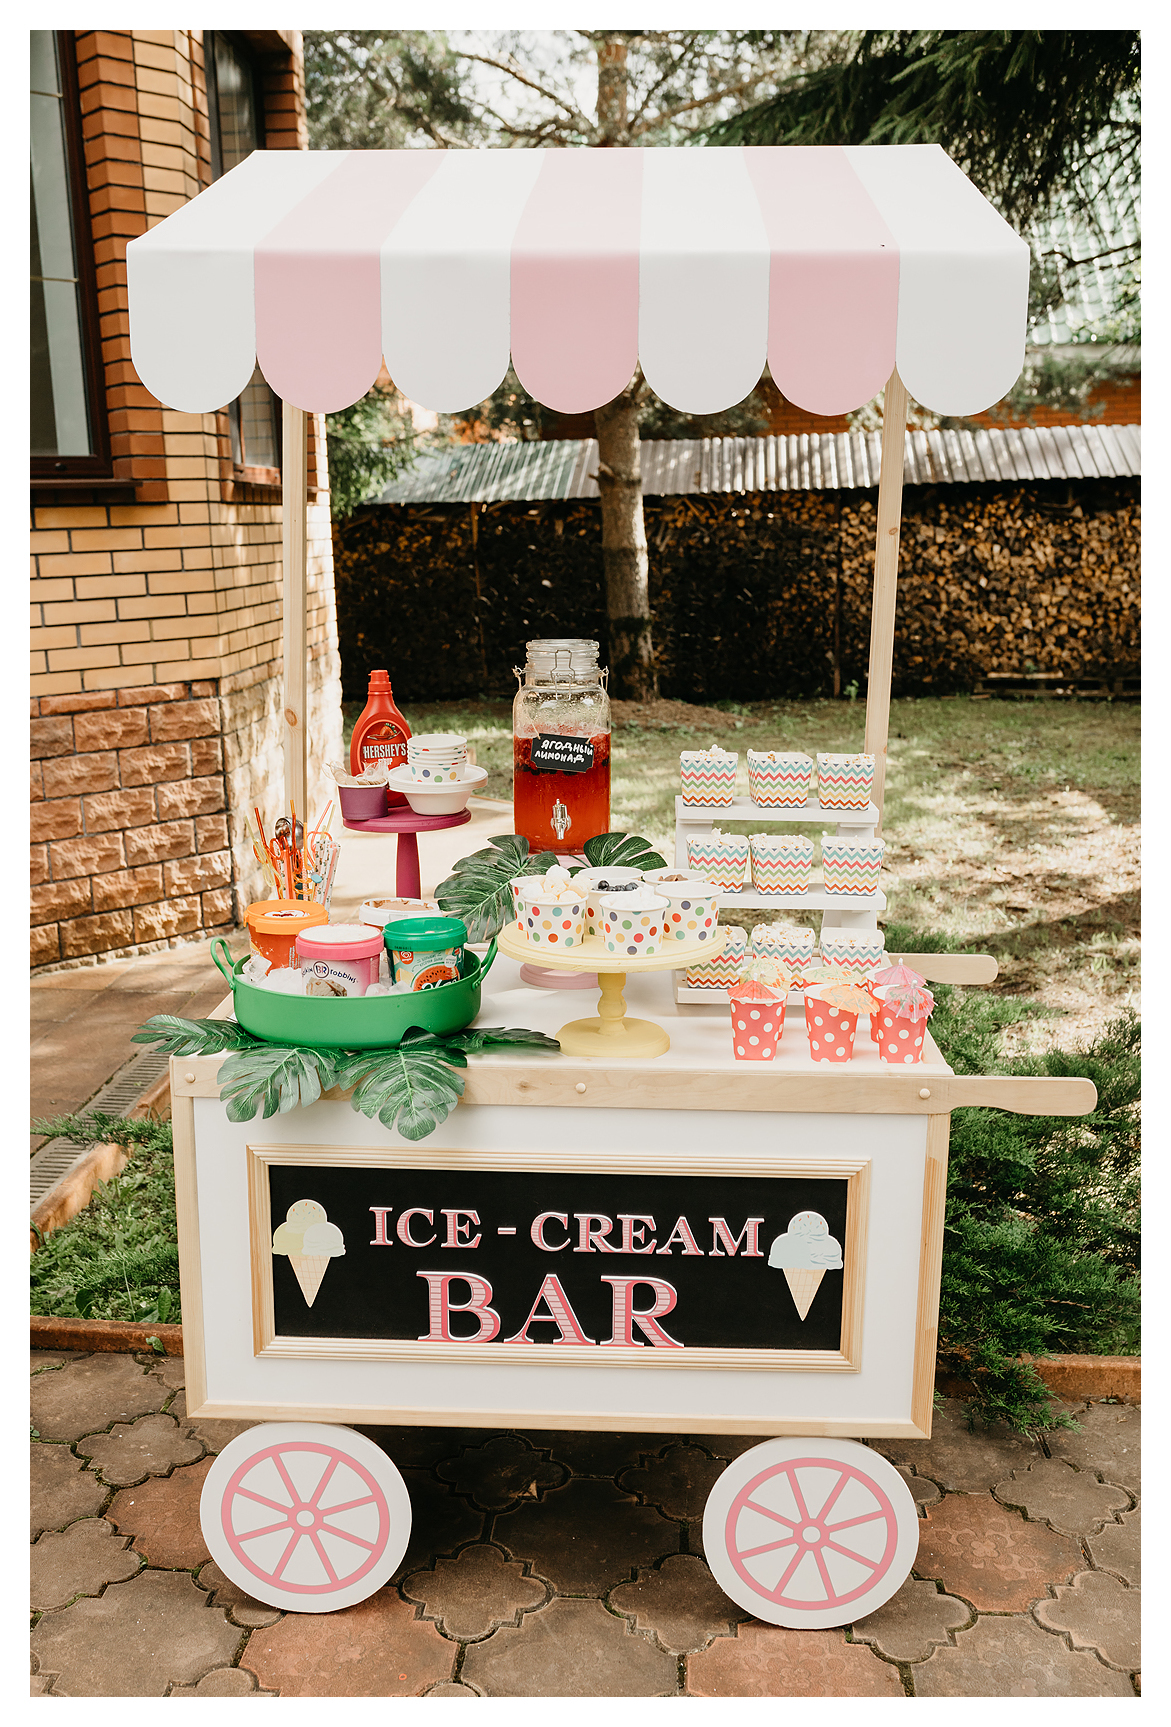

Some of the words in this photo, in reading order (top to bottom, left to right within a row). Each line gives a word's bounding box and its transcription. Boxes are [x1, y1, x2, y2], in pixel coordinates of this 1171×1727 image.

[363, 743, 406, 759] HERSHEY'S
[369, 1206, 482, 1249] ICE
[530, 1211, 765, 1257] CREAM
[416, 1271, 685, 1348] BAR
